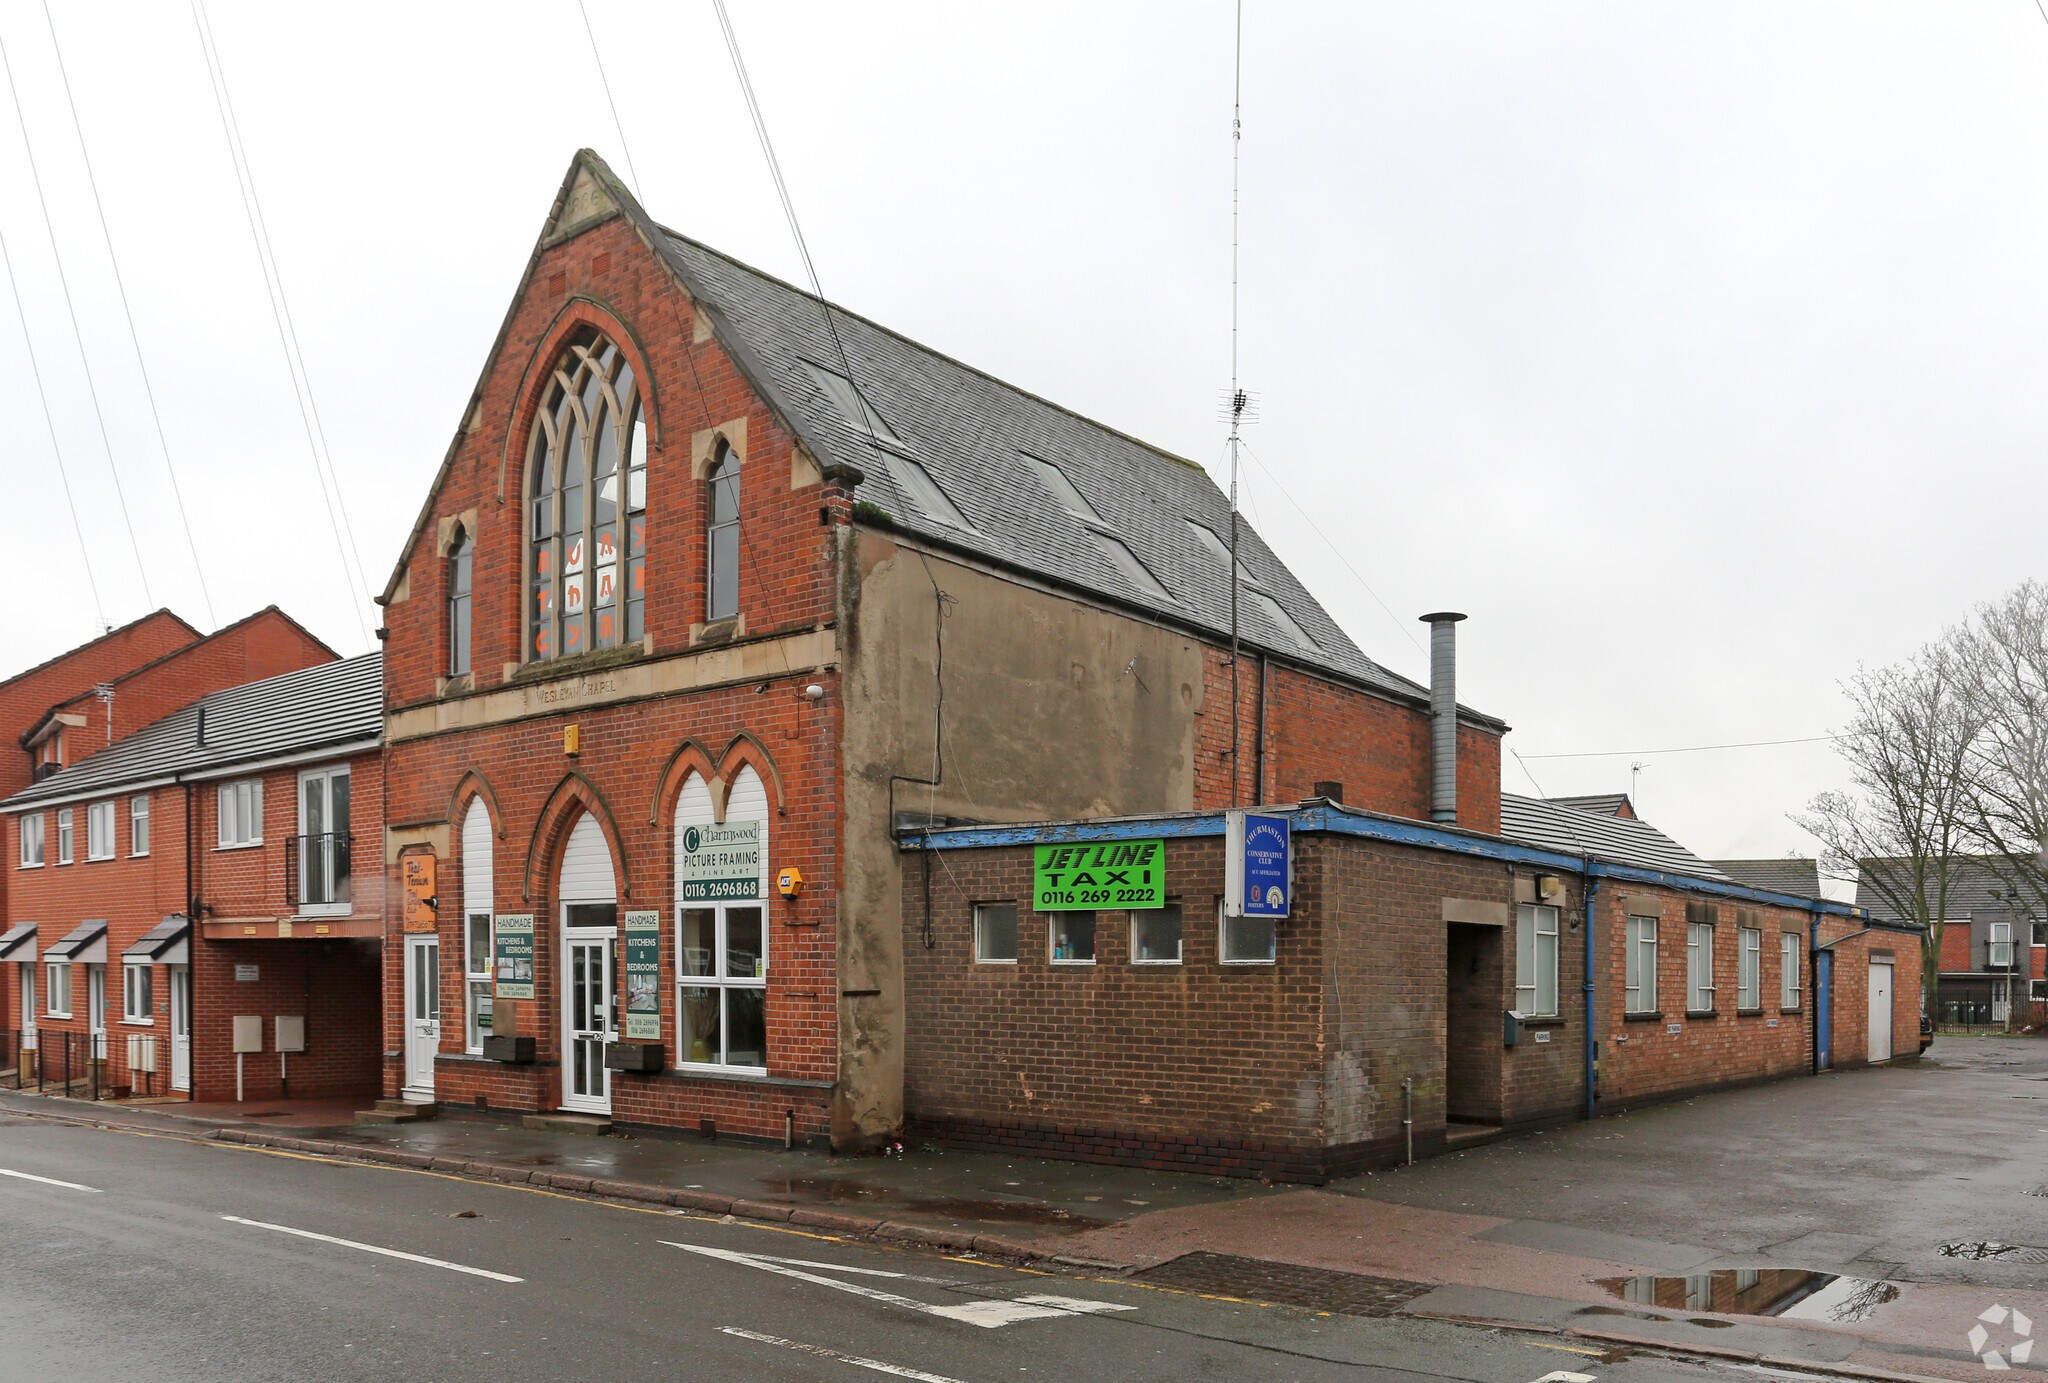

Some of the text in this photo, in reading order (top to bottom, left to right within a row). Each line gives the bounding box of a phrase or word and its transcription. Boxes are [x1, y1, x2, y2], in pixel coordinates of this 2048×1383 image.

[581, 680, 616, 697] CHAPEL
[1246, 825, 1286, 848] THURMASTON
[684, 851, 758, 867] PICTURE FRAMING
[1040, 844, 1158, 869] JET LINE
[1247, 850, 1284, 859] CONSERVATIVE
[1044, 870, 1151, 887] TAXI
[685, 881, 757, 897] 0116 2696868
[1041, 888, 1155, 904] 0116 269 2222
[498, 918, 531, 928] HANDMADE
[627, 915, 656, 925] HANDMADE
[628, 938, 656, 946] KITCHENS
[505, 946, 533, 954] BEDROOMS
[640, 950, 645, 959] &
[626, 963, 658, 972] BEDROOMS
